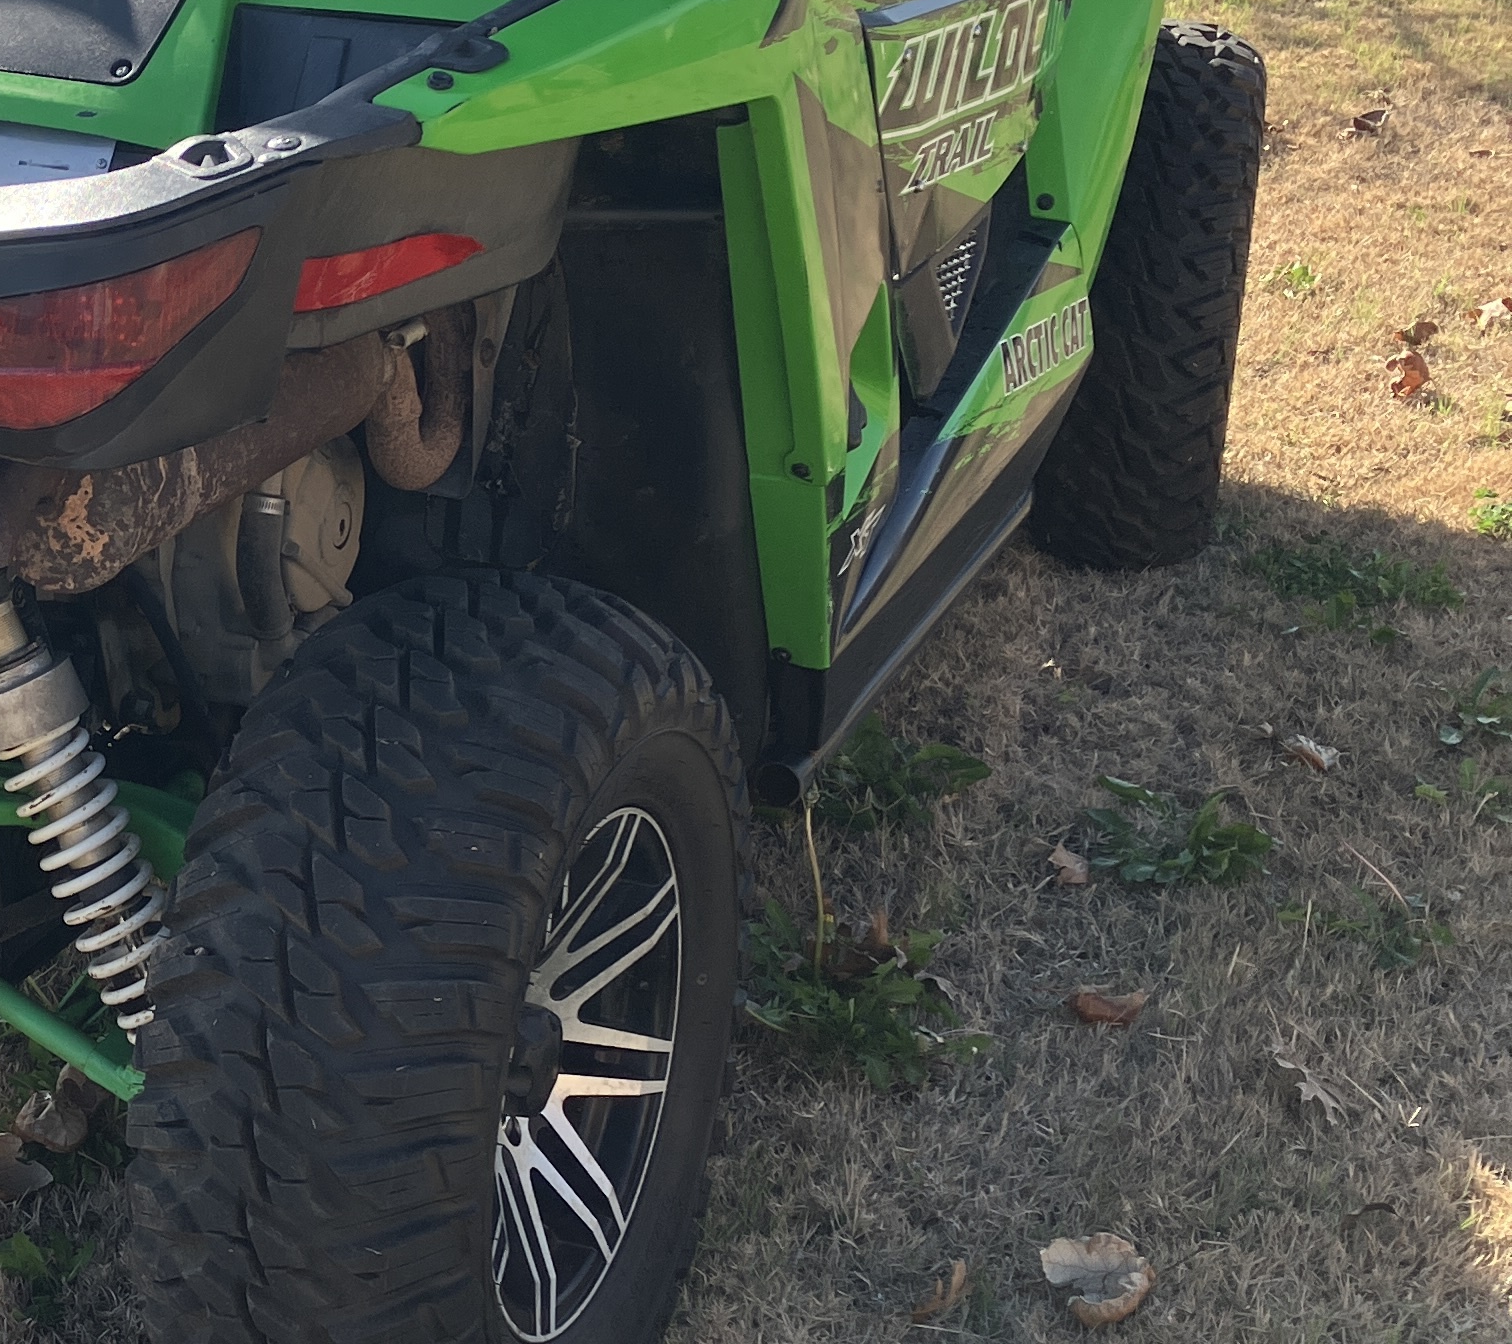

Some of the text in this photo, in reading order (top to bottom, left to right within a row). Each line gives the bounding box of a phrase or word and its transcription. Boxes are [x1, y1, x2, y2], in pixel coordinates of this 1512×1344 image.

[898, 110, 999, 196] TRAIL
[999, 296, 1089, 397] ARCTIC CAT
